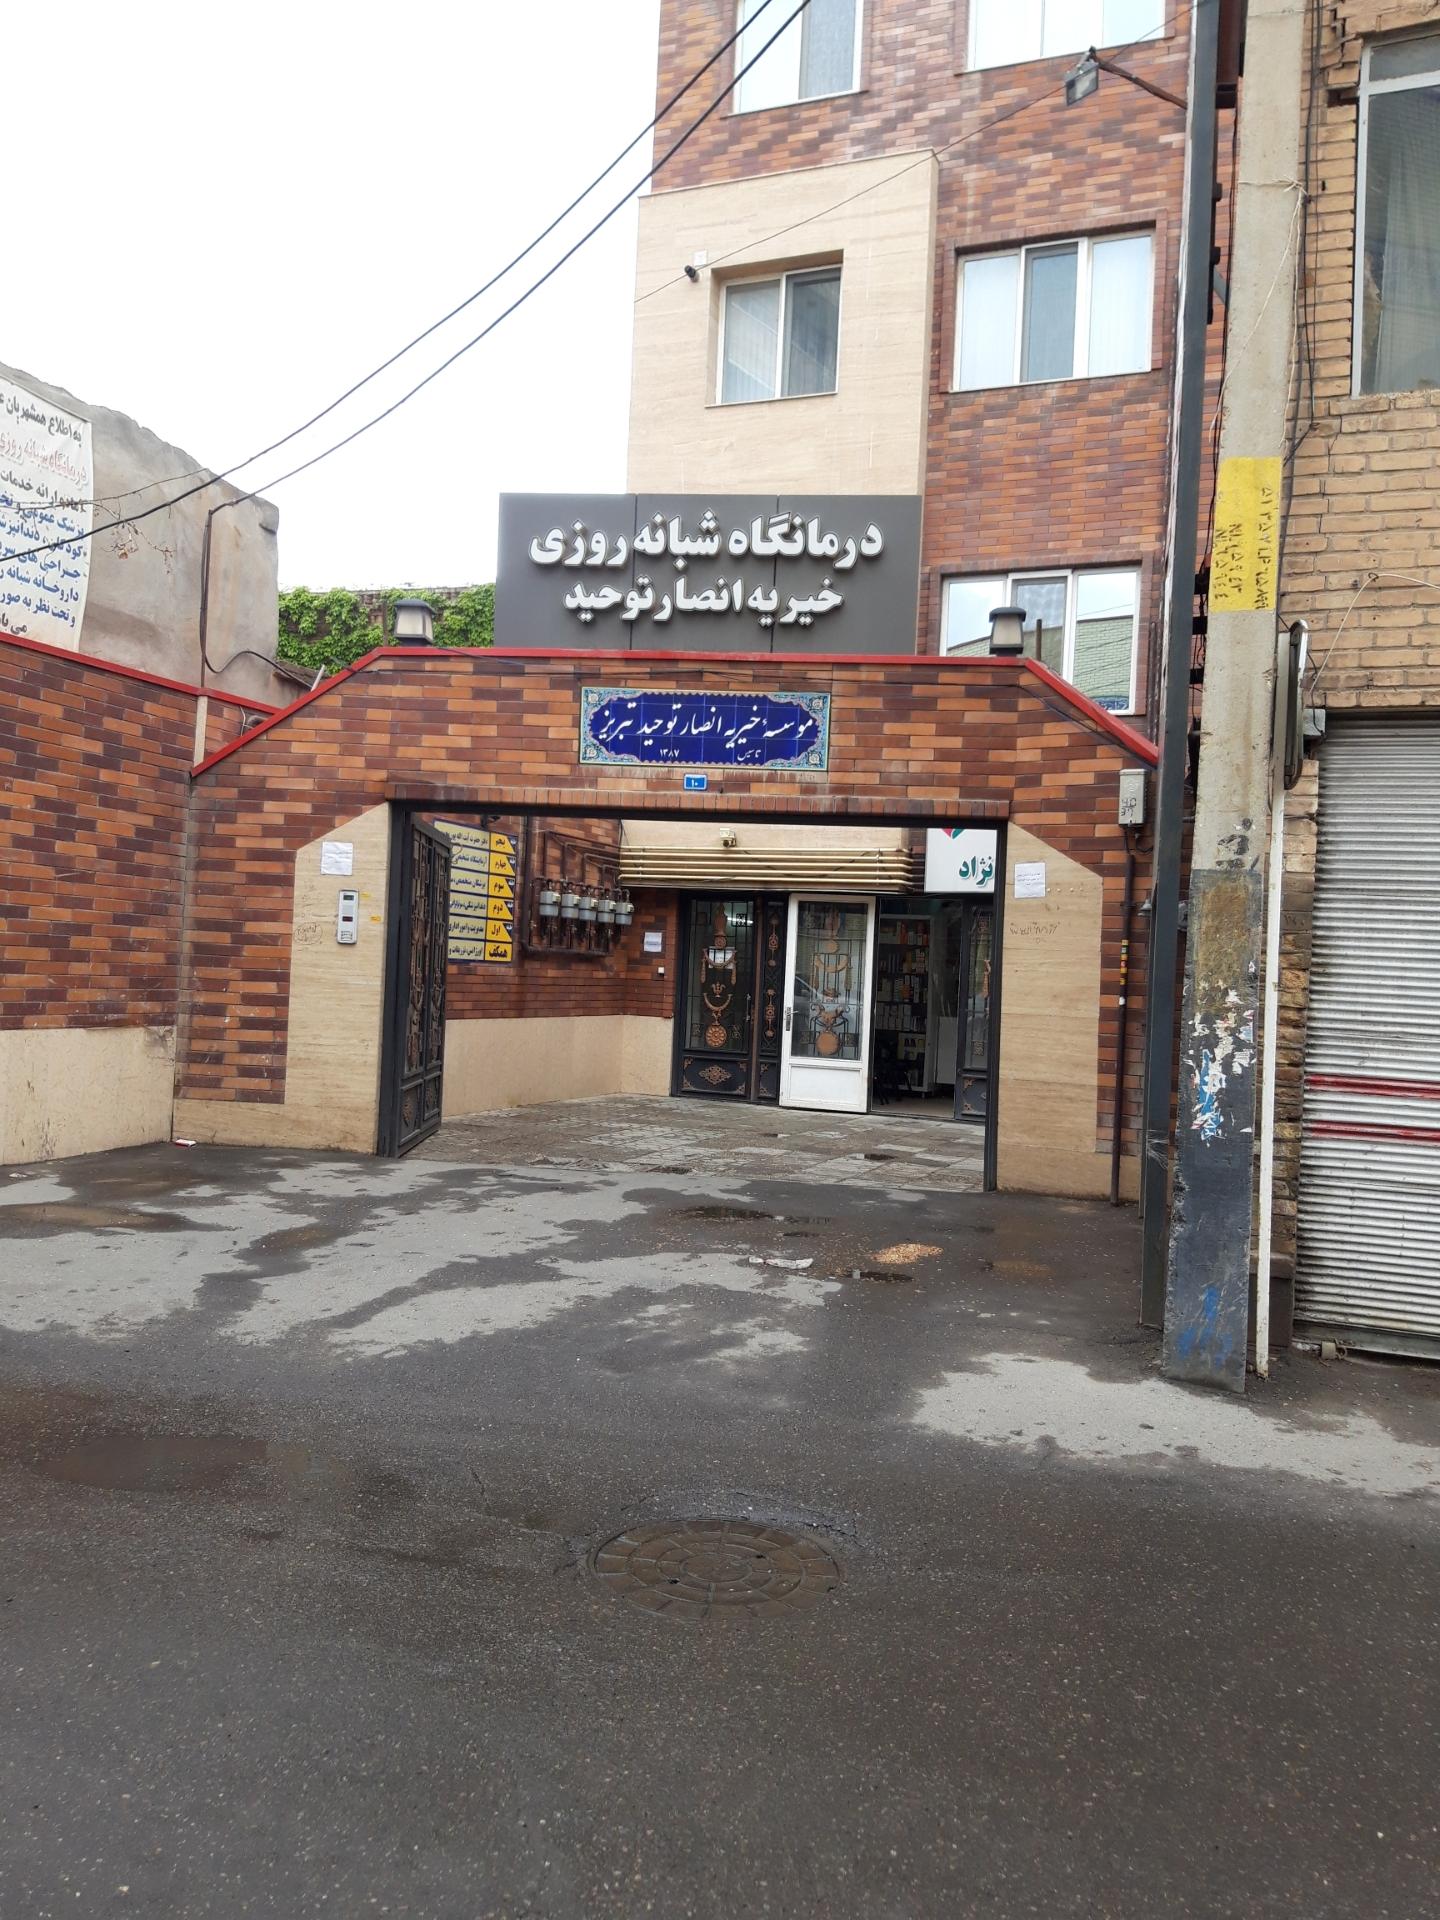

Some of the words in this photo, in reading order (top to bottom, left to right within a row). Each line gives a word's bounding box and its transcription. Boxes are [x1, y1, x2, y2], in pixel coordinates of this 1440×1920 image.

[6, 396, 47, 426] همشهریان
[48, 415, 72, 438] اطلاع
[73, 430, 82, 448] به
[1, 471, 33, 491] خدمات
[528, 518, 630, 567] روزی
[632, 507, 721, 571] شبانه
[728, 510, 884, 571] درمانگاه
[6, 565, 30, 585] شبانه
[40, 560, 81, 583] جراحی
[33, 574, 79, 602] داروخانه
[563, 573, 655, 624] توحید
[651, 575, 744, 622] انصار
[746, 576, 845, 629] خیریه
[22, 596, 32, 611] به
[33, 598, 50, 613] نظر
[52, 605, 70, 621] تحت
[10, 624, 27, 635] می
[599, 701, 637, 742] تبریز
[636, 702, 682, 747] توحید
[679, 706, 723, 737] انصار
[723, 705, 760, 749] خیریه
[958, 856, 994, 886] نژاد
